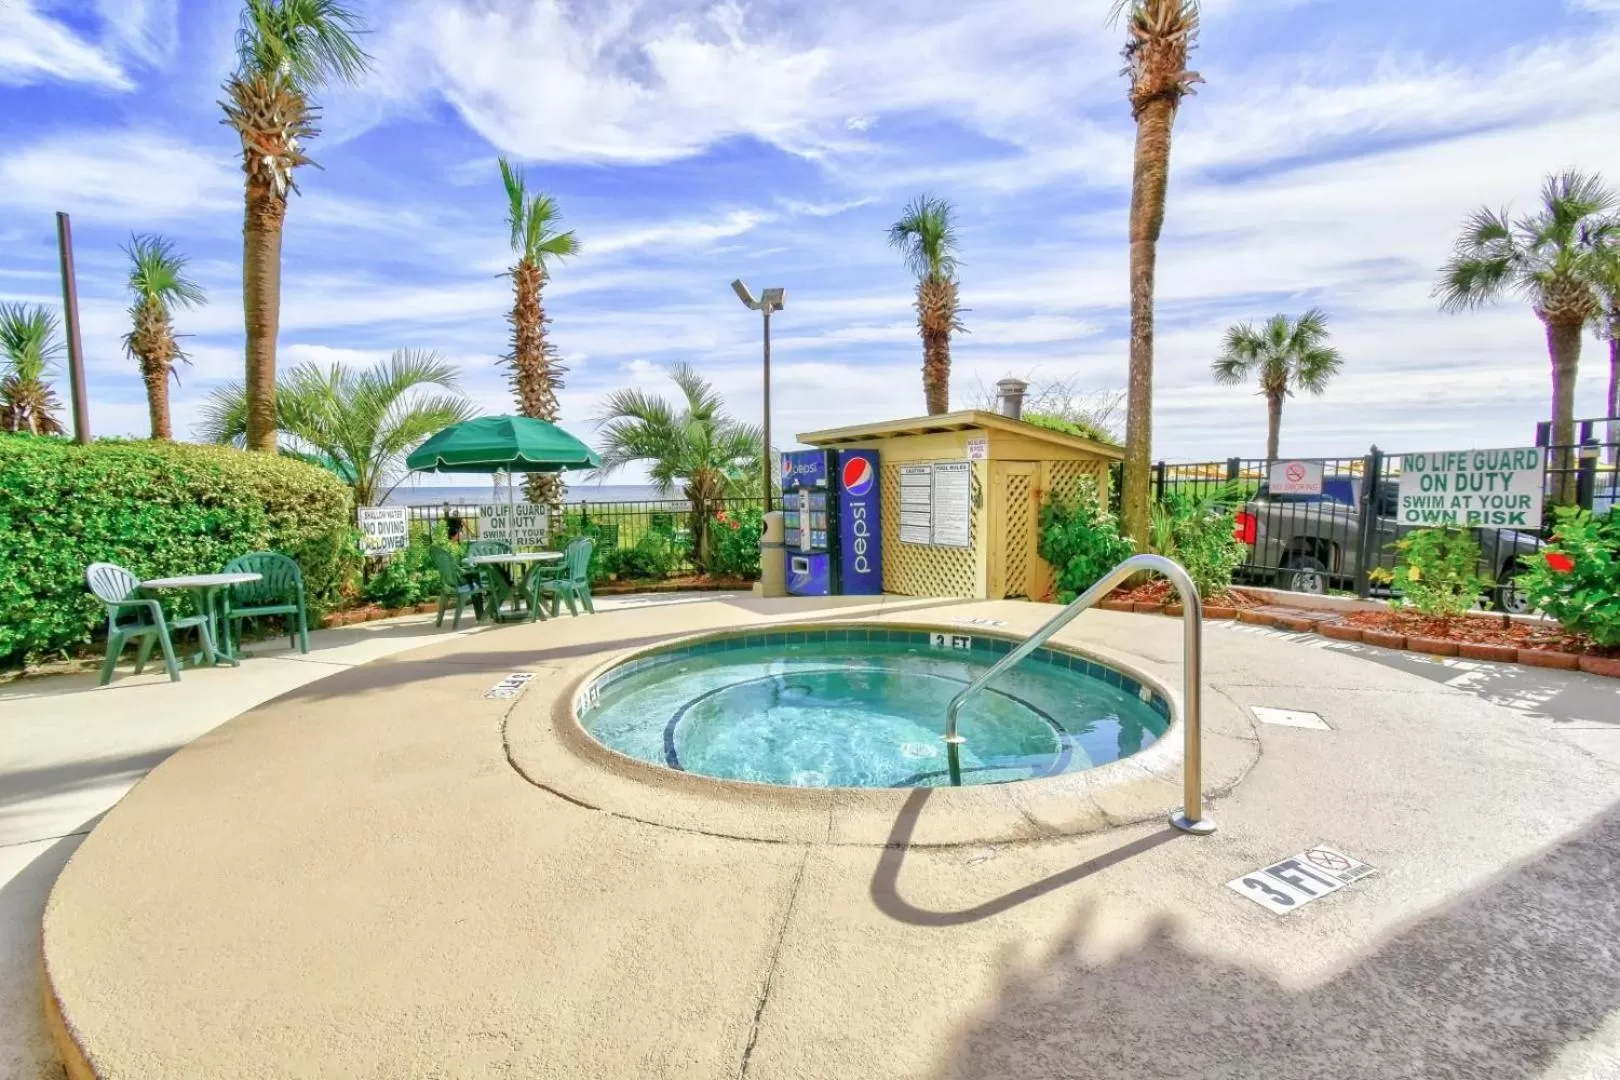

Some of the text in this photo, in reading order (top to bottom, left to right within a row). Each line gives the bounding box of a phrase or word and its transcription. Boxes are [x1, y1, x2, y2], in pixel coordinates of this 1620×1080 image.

[1403, 450, 1539, 472] NO LIFE GUARD
[793, 463, 817, 474] pepsi
[1420, 472, 1514, 492] ON DUTY
[1403, 495, 1531, 509] SWIM AT YOUR
[480, 505, 545, 517] NO LIF GUARD
[1406, 510, 1457, 523] OWN
[364, 521, 404, 535] NO DIVING
[491, 518, 505, 528] ON
[484, 530, 506, 538] SWIM
[522, 529, 545, 537] YOUR
[849, 502, 871, 574] pepsi
[517, 537, 544, 545] RISK
[952, 636, 970, 649] FT
[1265, 860, 1336, 896] FT
[1242, 878, 1295, 906] 3
